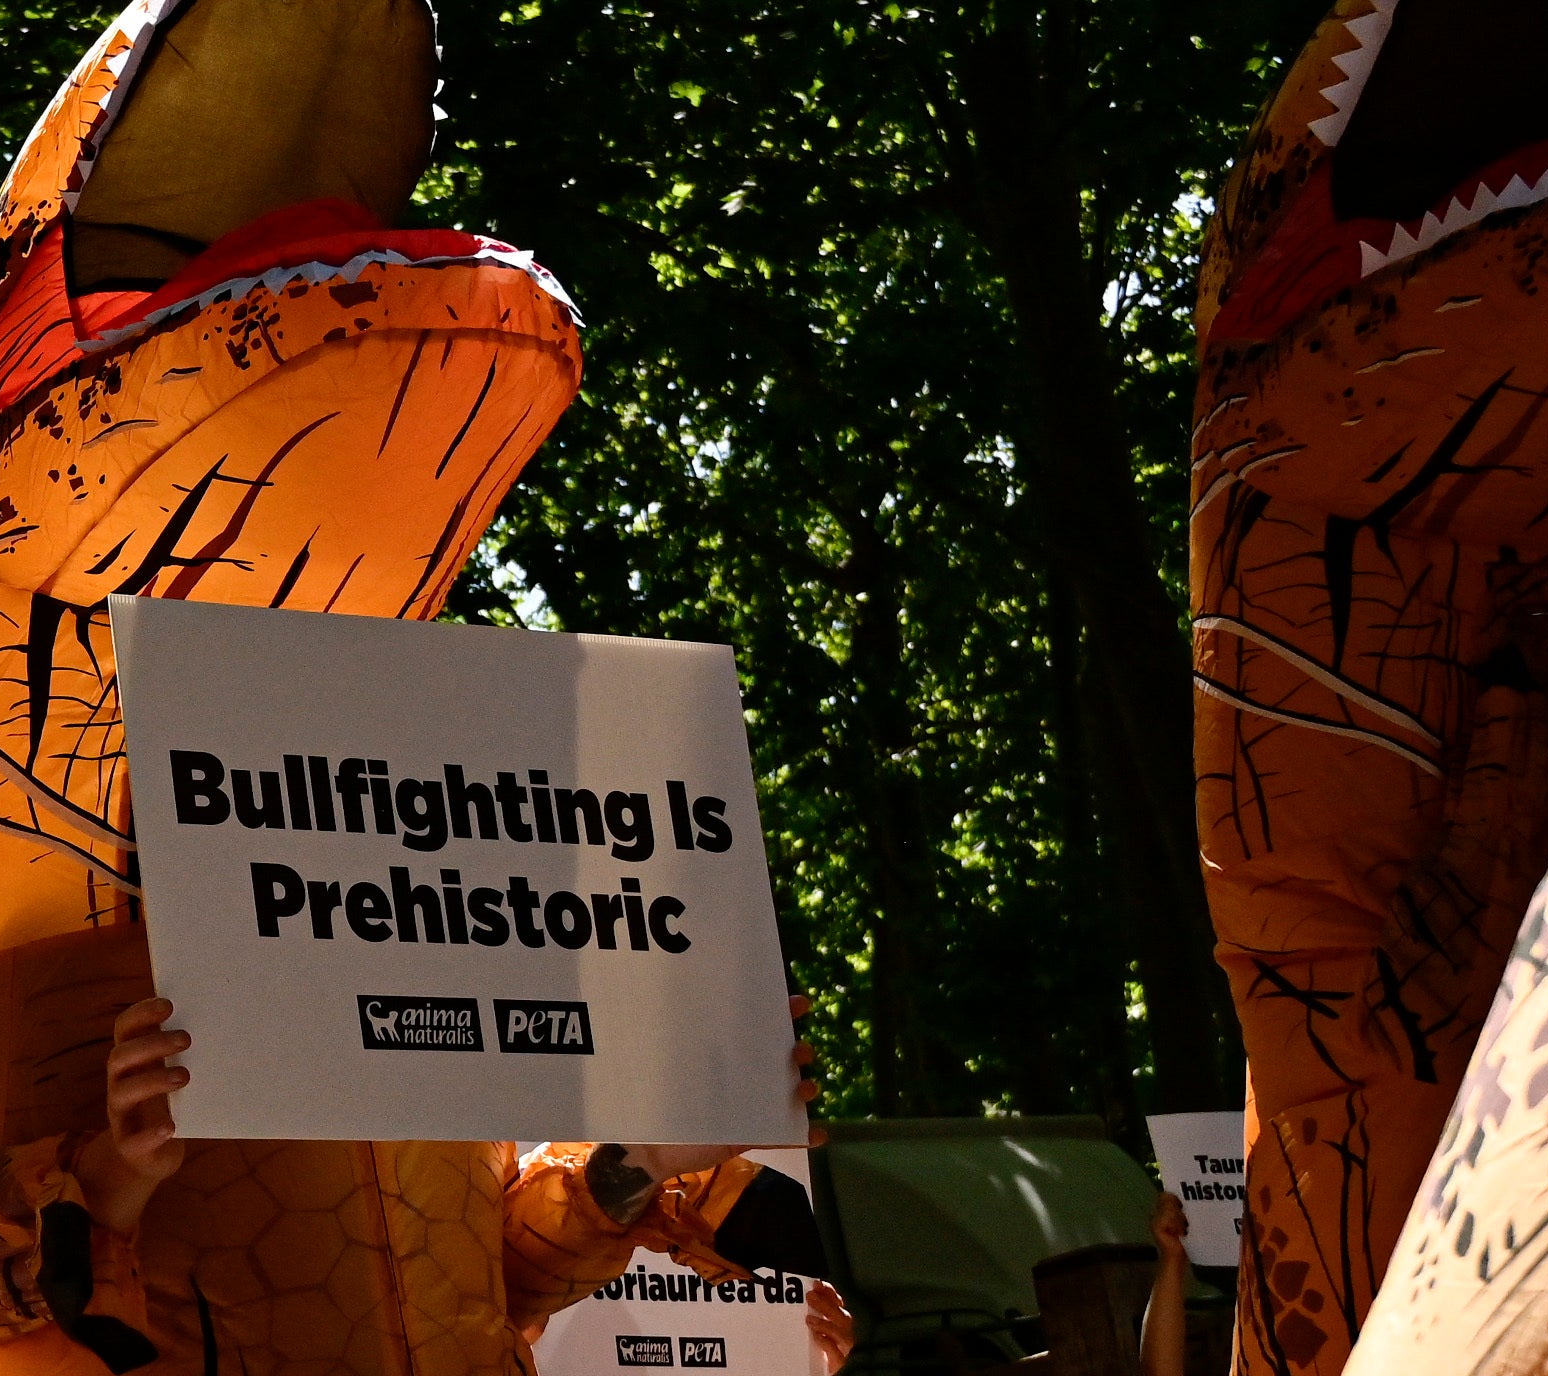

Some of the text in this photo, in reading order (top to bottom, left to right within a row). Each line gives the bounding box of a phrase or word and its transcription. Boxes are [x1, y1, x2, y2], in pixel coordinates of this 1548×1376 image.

[169, 749, 732, 862] Bullfighting Is
[249, 862, 692, 954] Prehistoric
[401, 1004, 471, 1027] anima
[403, 1024, 475, 1045] naturalis
[593, 1265, 804, 1303] oriaurrea da
[635, 1340, 669, 1353] anima
[636, 1352, 669, 1364] naturalis
